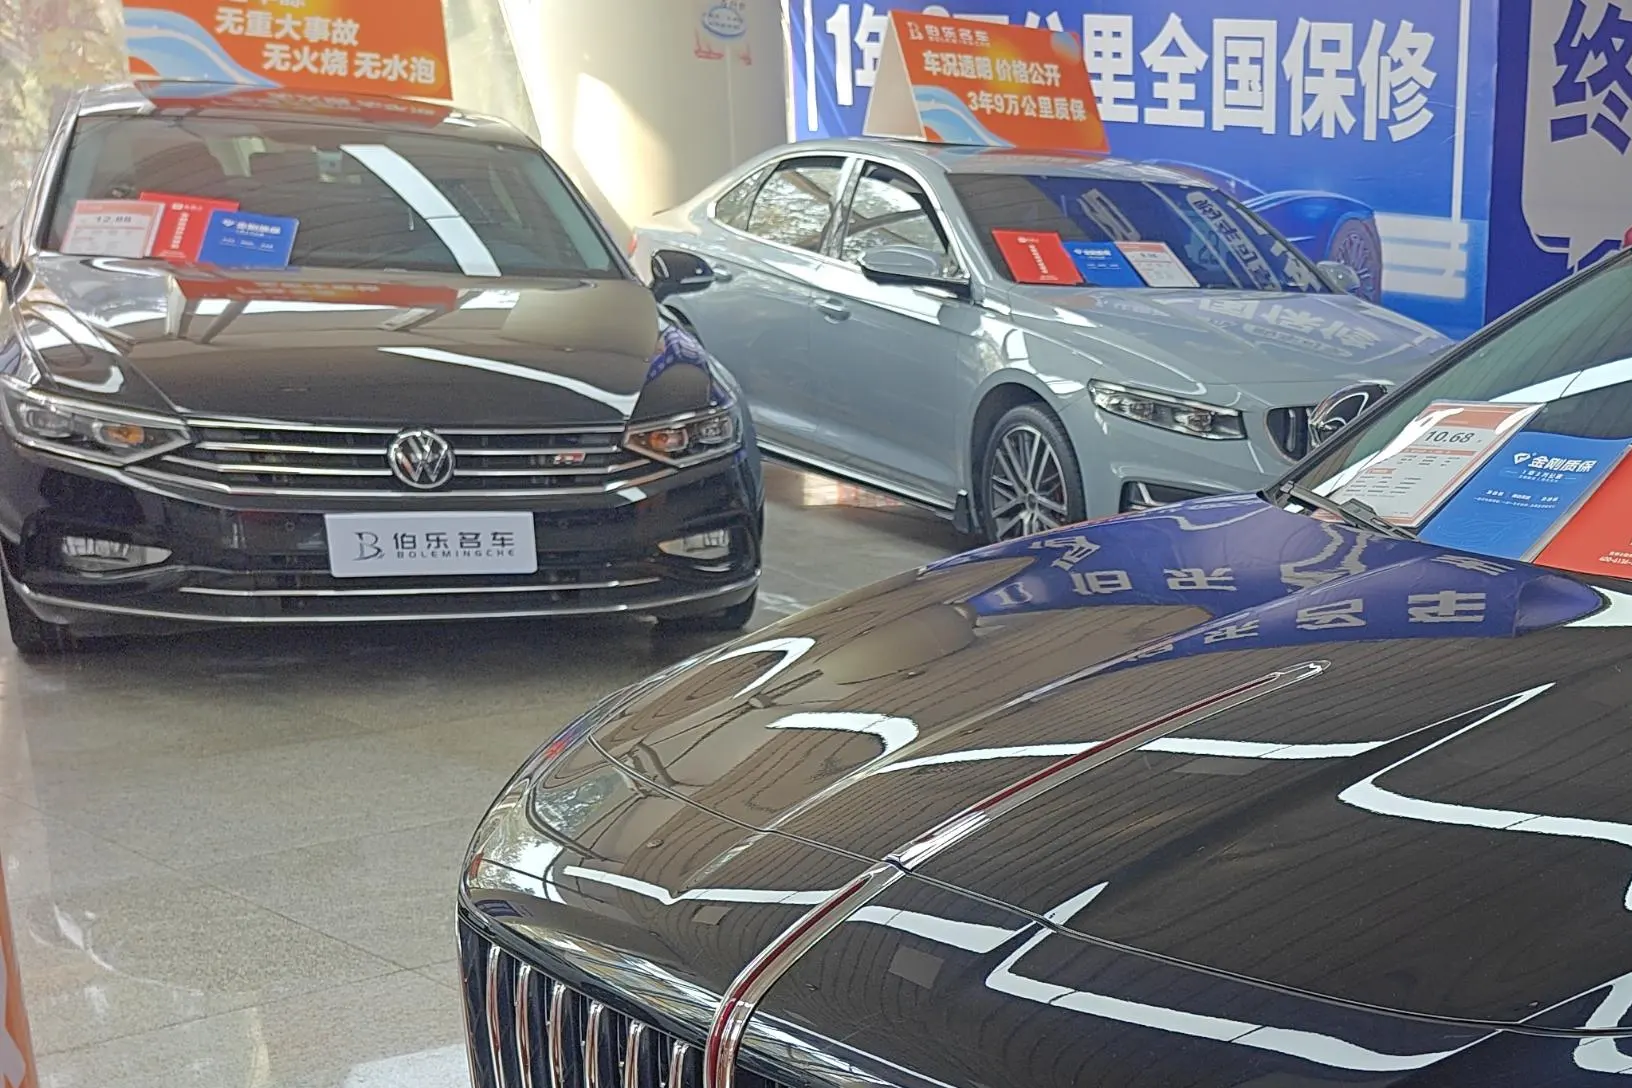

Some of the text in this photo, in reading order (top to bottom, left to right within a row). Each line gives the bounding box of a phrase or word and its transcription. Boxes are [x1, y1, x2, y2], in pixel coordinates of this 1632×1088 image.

[214, 6, 361, 47] 无重大事故
[261, 43, 436, 84] 无火烧 无水泡
[922, 50, 1062, 87] 车况透明 价格公开
[966, 90, 1087, 122] 3年9万公里质保
[1424, 430, 1476, 444] 10.68
[1528, 454, 1598, 473] 金刚质保
[393, 531, 515, 551] 伯乐名车
[396, 550, 515, 558] BOLEMINGCHE
